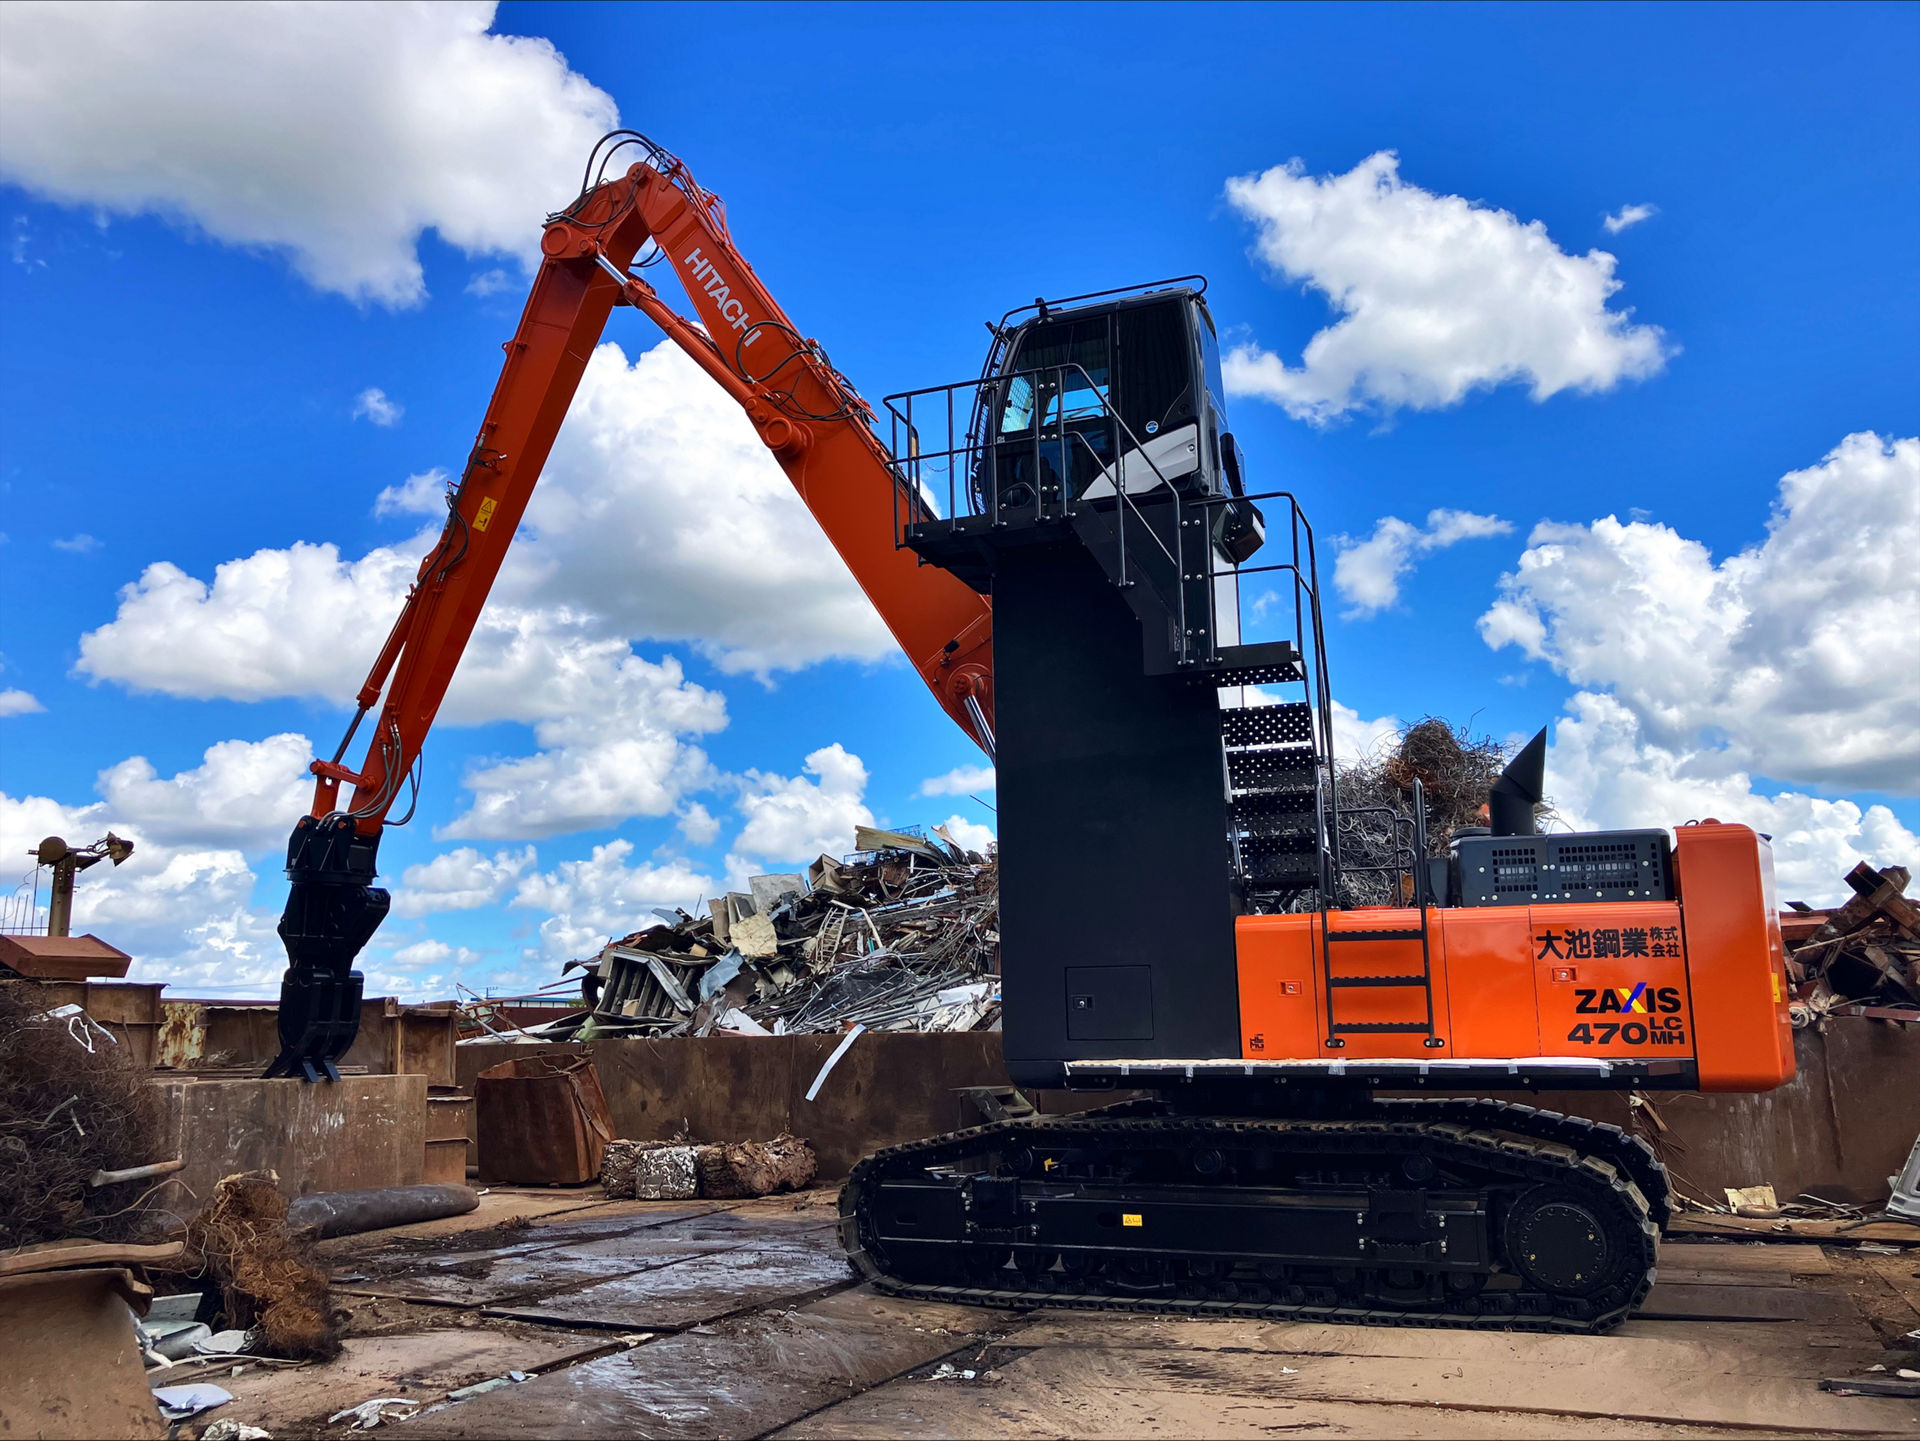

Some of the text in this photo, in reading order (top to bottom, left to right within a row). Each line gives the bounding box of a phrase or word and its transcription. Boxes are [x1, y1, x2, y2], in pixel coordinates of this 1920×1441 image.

[684, 247, 762, 347] HITACHI
[1535, 927, 1650, 960] 大池鋼業
[1574, 982, 1682, 1014] ZAXIS
[1567, 1016, 1683, 1045] 470 LC
[1651, 1031, 1685, 1045] MH
